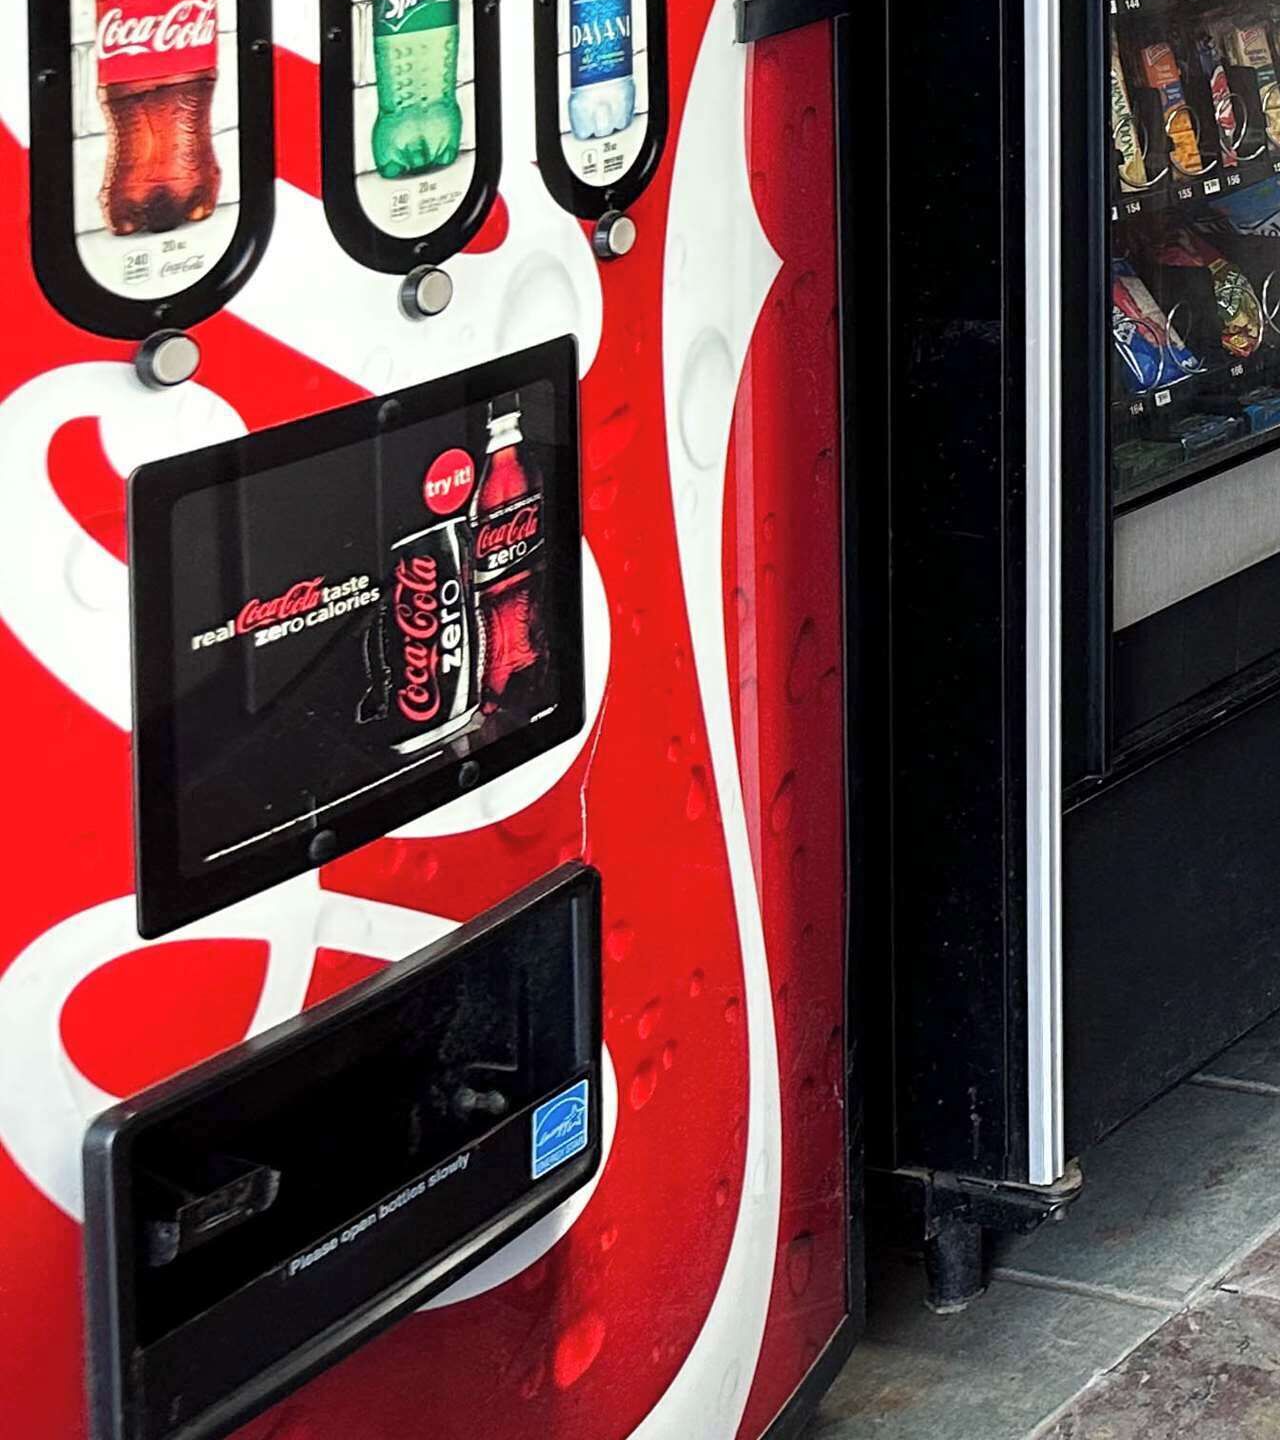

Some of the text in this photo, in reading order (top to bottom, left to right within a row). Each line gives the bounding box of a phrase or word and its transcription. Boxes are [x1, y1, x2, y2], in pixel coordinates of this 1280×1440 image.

[572, 14, 631, 49] DASANI
[1125, 202, 1141, 213] 154
[127, 253, 148, 268] 240
[424, 464, 473, 498] try it!
[475, 506, 539, 560] Coca-Cola
[488, 540, 528, 571] zero
[191, 575, 370, 650] real Coca-Cola taste
[254, 587, 381, 648] zero calories
[396, 555, 441, 722] Coca-Cola
[441, 580, 461, 674] zero
[289, 1152, 471, 1276] Please open bottles slowly
